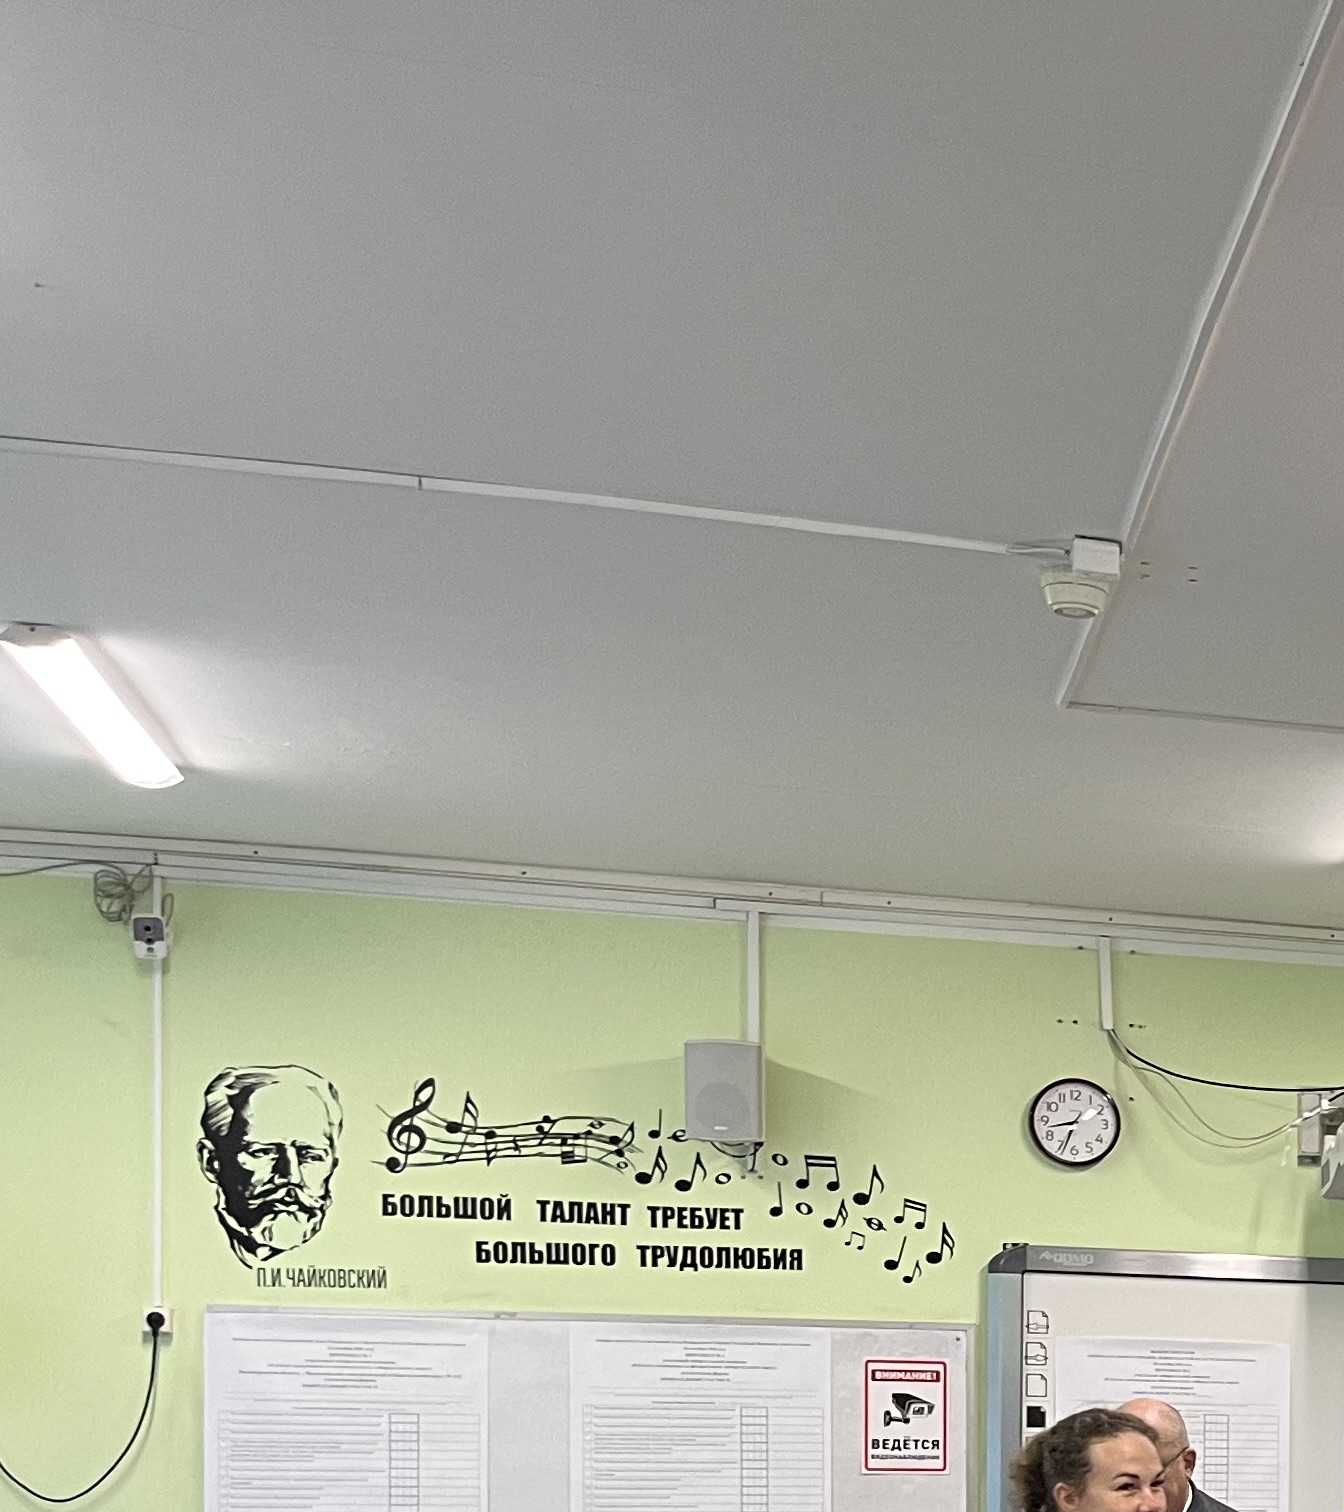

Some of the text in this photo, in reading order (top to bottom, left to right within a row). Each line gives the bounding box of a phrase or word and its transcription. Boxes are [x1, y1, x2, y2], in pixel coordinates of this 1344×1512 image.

[1058, 1093, 1066, 1103] 11
[1070, 1090, 1082, 1101] 12
[1046, 1102, 1059, 1112] 10
[1097, 1104, 1104, 1115] 2
[1041, 1115, 1049, 1126] 9
[1101, 1119, 1108, 1130] 3
[1046, 1130, 1054, 1141] 8
[1095, 1134, 1103, 1144] 4
[1056, 1140, 1064, 1153] 7
[1070, 1145, 1079, 1156] 6
[1085, 1142, 1093, 1153] 5
[382, 1194, 744, 1230] БОЛЬШОЙ ТАЛАНТ ТРЕБУЕТ
[476, 1241, 804, 1272] БОЛЬШОГО ТРУДОЛЮБИЯ
[872, 1436, 940, 1451] ВЕДЁТСЯ
